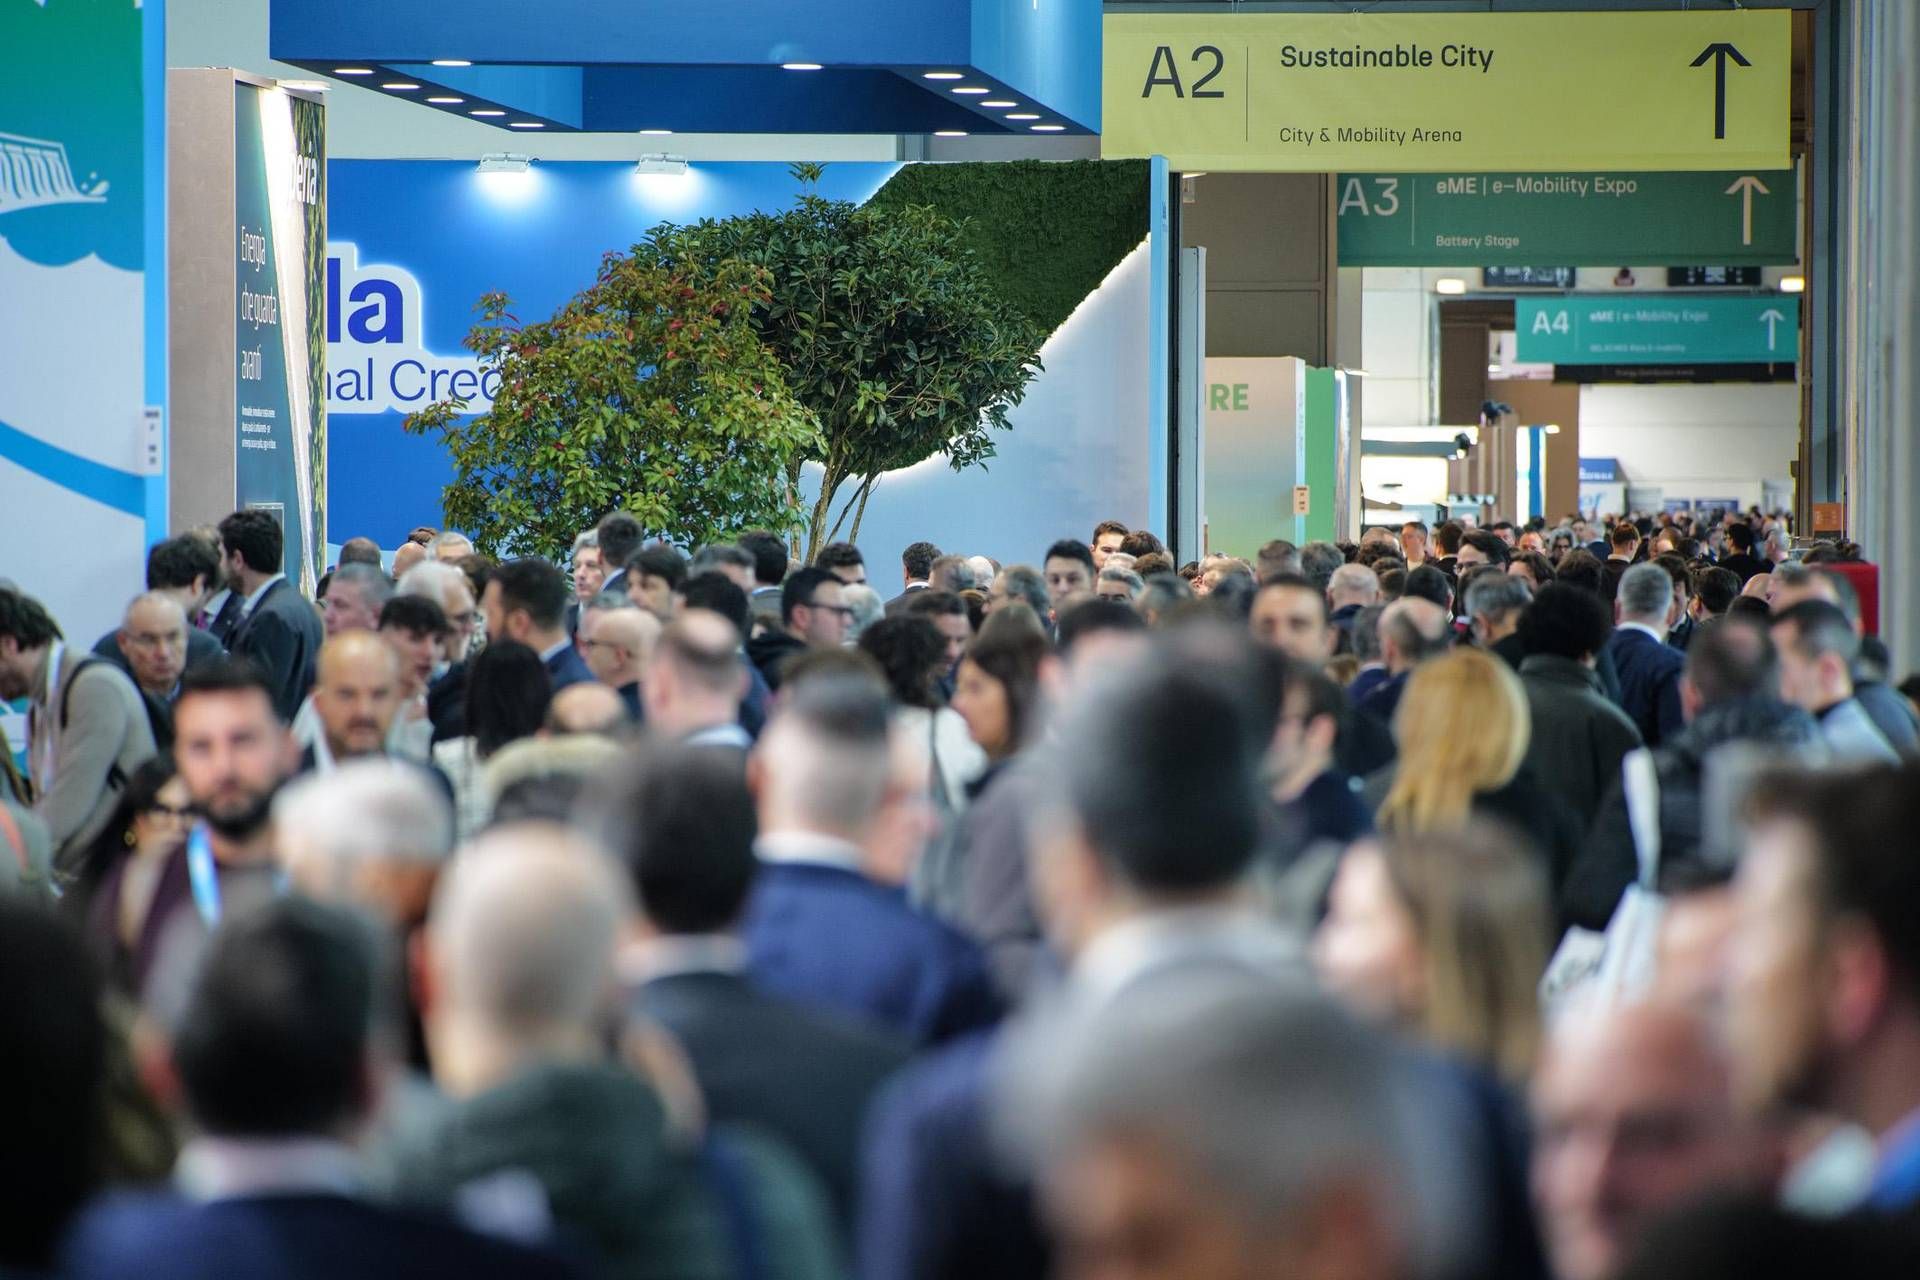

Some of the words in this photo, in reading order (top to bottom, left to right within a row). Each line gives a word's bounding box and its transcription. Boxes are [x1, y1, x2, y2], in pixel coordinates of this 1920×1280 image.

[1141, 45, 1225, 98] A2
[1280, 45, 1433, 68] Sustainable
[1441, 45, 1494, 73] City
[1279, 127, 1312, 146] City
[1319, 127, 1331, 142] &
[1337, 127, 1406, 146] Mobility
[1411, 127, 1462, 142] Arena
[1338, 178, 1399, 216] A3
[1436, 177, 1477, 194] eME
[1492, 176, 1588, 197] e-Mobility
[1594, 177, 1637, 197] Expo
[241, 226, 266, 273] Energia
[1436, 234, 1481, 249] Battery
[1484, 234, 1520, 249] Stage
[241, 283, 253, 321] che
[254, 287, 277, 331] guarda
[1532, 310, 1569, 335] A4
[1205, 383, 1249, 411] RE
